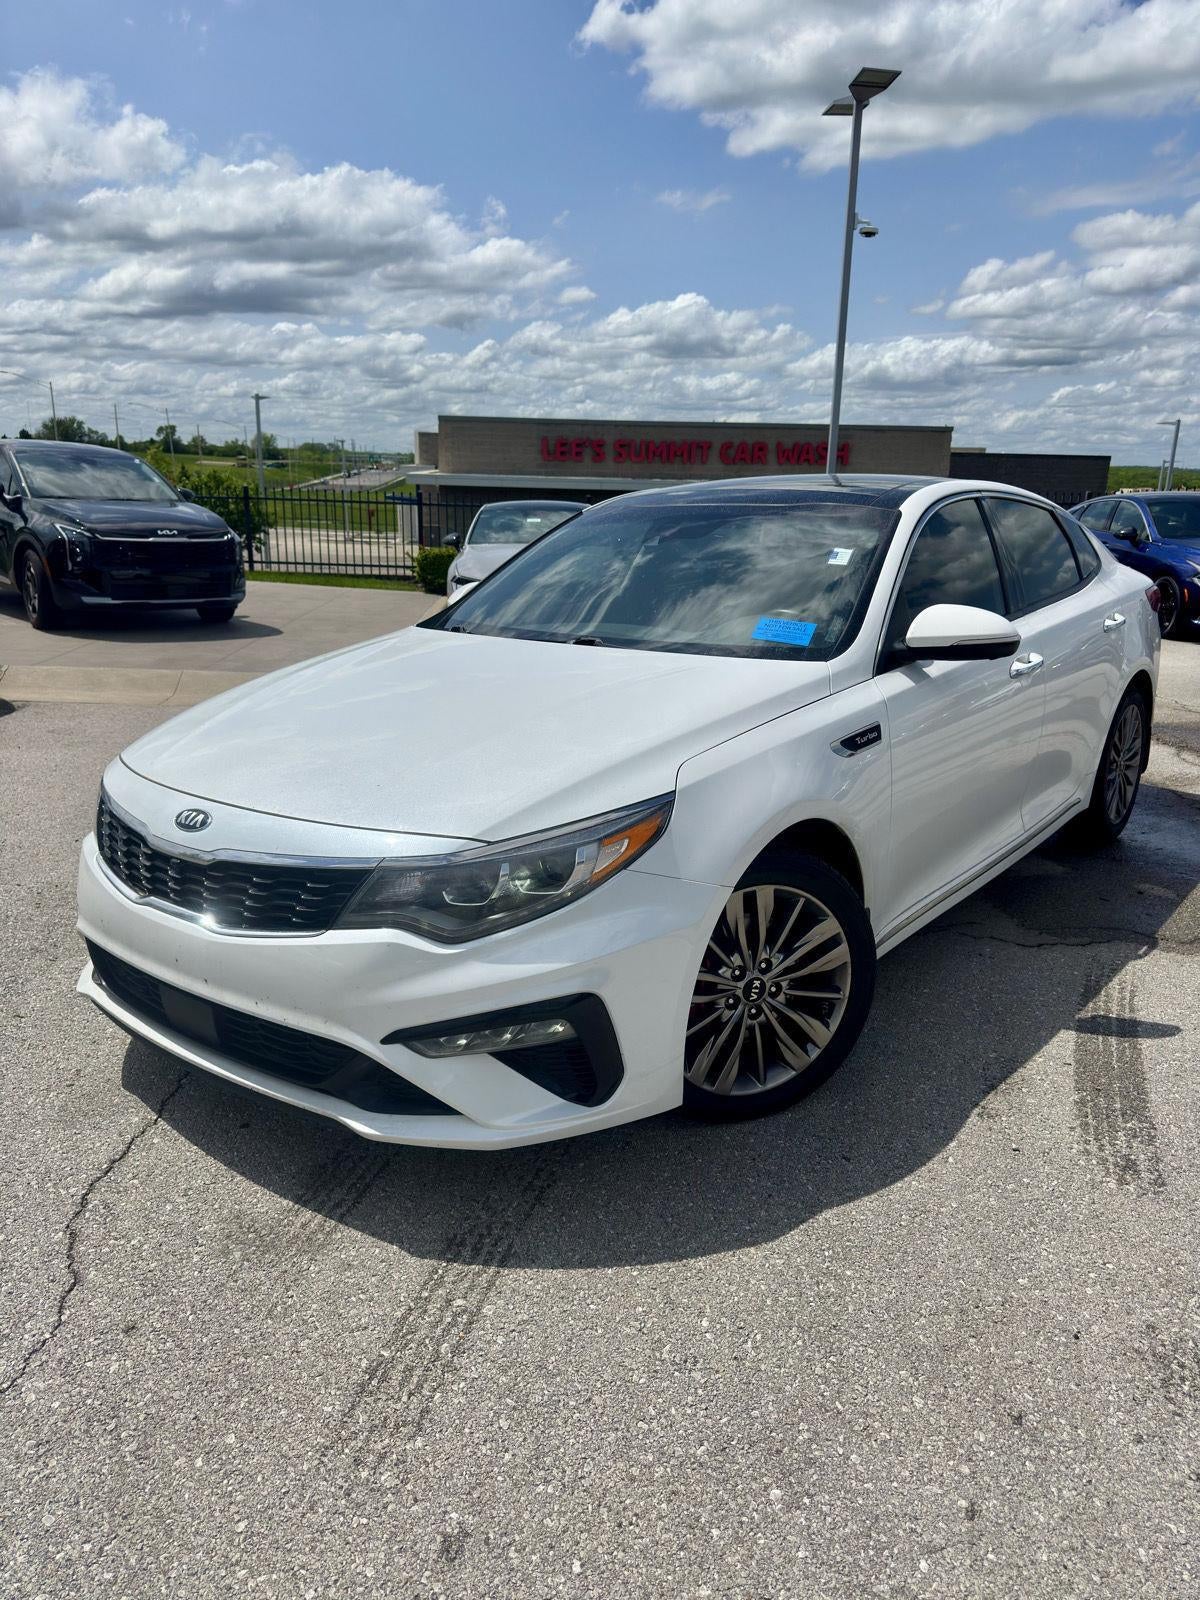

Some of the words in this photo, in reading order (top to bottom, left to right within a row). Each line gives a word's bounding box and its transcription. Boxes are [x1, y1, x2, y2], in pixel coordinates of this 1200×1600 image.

[541, 436, 607, 463] LEE'S
[613, 438, 711, 465] SUMMIT
[719, 440, 769, 466] CAR
[776, 441, 850, 467] WASH
[855, 731, 878, 744] Turbo
[176, 810, 205, 828] KIA
[749, 980, 761, 1001] KIA
